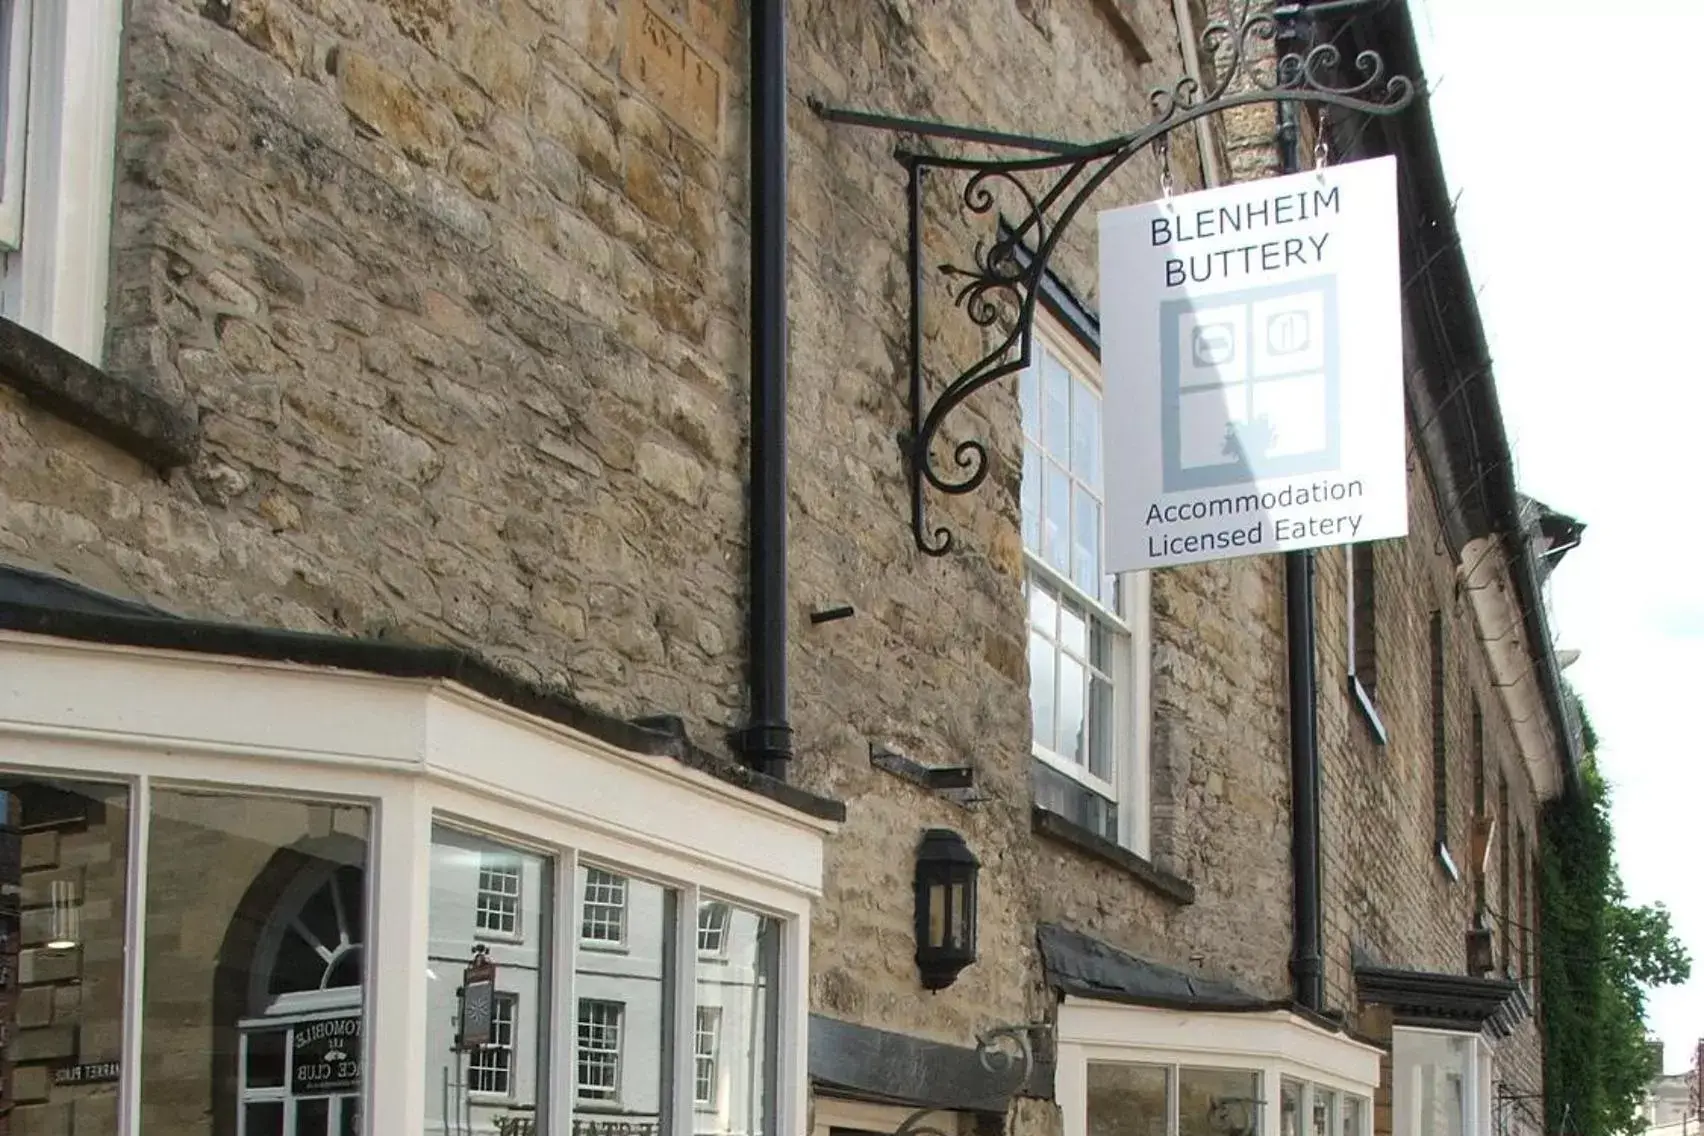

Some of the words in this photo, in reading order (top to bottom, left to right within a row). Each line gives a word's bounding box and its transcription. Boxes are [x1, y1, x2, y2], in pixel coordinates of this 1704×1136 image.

[1151, 187, 1341, 246] BLENHEIM
[1165, 232, 1330, 288] BUTTERY
[1146, 478, 1363, 525] Accommodation
[1148, 522, 1262, 558] Licensed
[1275, 513, 1363, 542] Eatery
